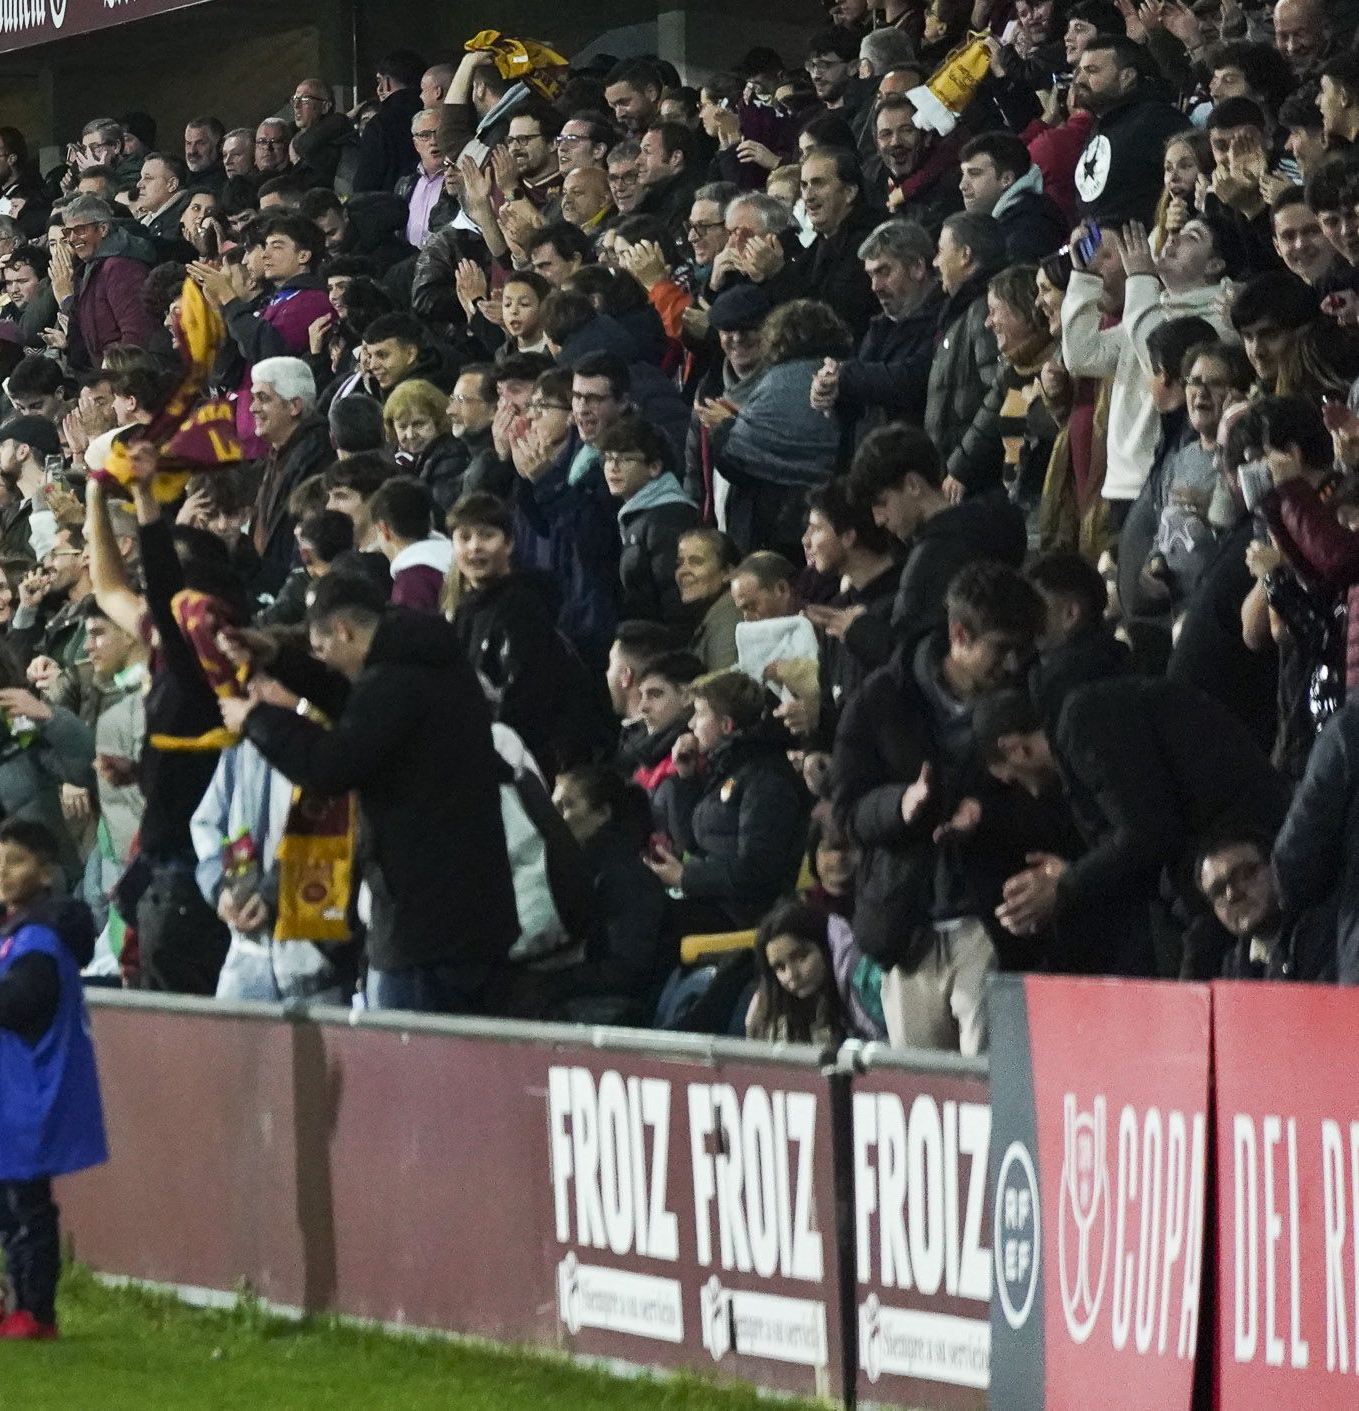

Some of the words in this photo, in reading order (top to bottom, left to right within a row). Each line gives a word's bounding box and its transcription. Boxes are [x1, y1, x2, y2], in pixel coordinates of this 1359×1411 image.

[549, 1066, 680, 1262] FROIZ
[687, 1083, 824, 1283] FROIZ
[853, 1092, 992, 1301] FROIZ
[1111, 1104, 1207, 1362] COPA
[1234, 1113, 1309, 1370] DEL
